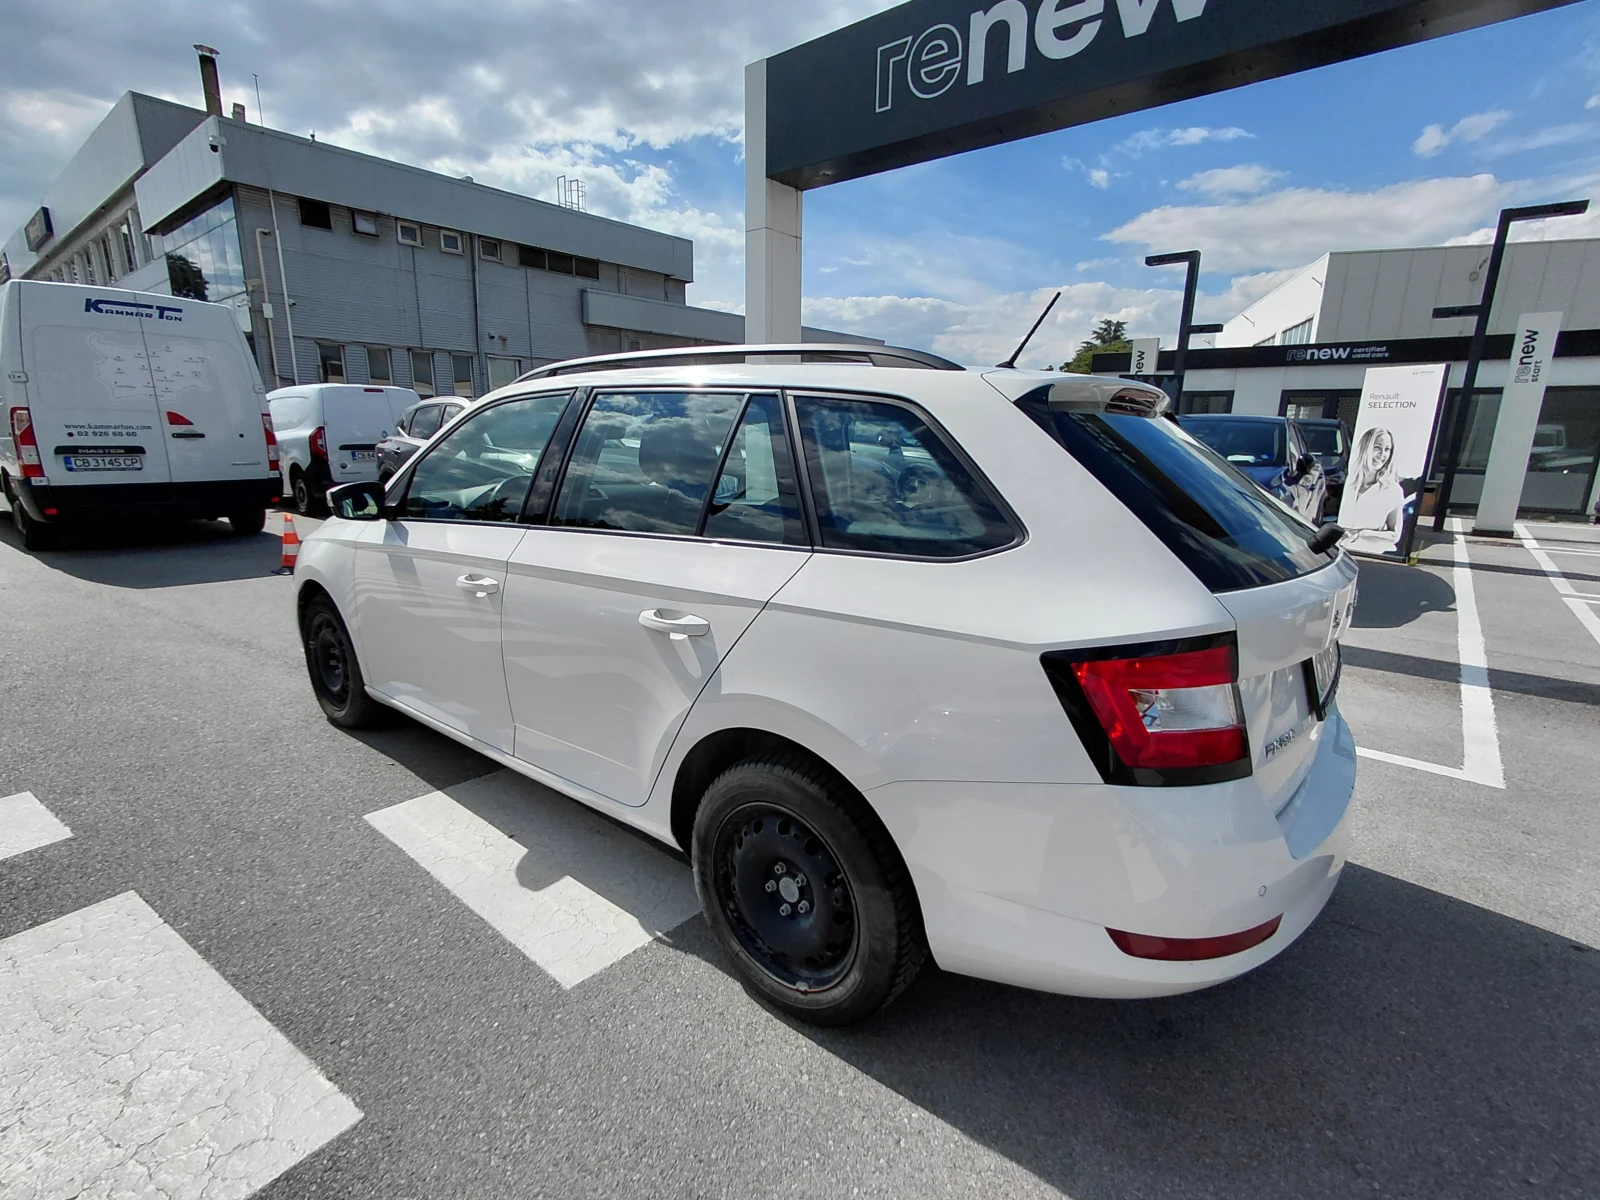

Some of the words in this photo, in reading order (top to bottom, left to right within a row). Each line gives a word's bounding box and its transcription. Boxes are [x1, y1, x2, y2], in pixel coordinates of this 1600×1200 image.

[1286, 347, 1350, 361] renew
[1514, 329, 1539, 383] renew
[1531, 360, 1542, 383] start
[1368, 401, 1417, 409] SELECTION
